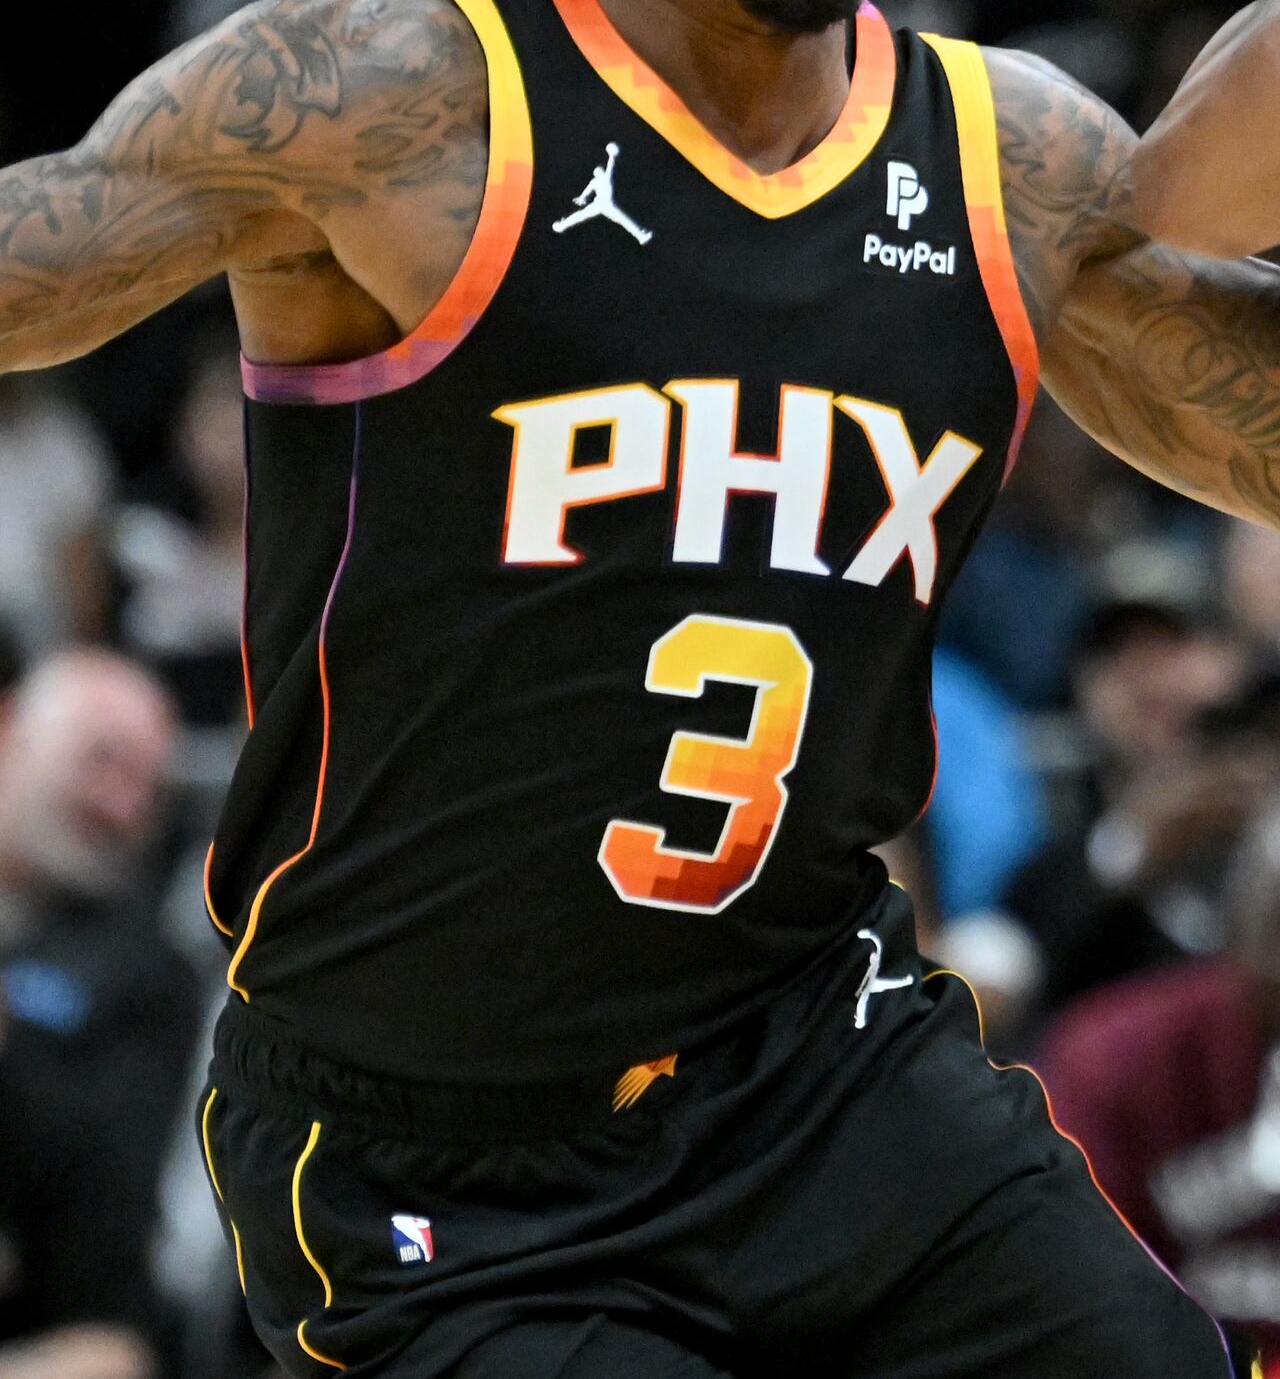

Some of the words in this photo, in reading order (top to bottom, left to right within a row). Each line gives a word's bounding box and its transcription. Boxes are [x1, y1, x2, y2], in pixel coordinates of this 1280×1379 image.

[863, 233, 956, 275] PayPal
[491, 377, 983, 608] PHX
[597, 613, 813, 915] 3
[399, 1244, 421, 1263] NBA
